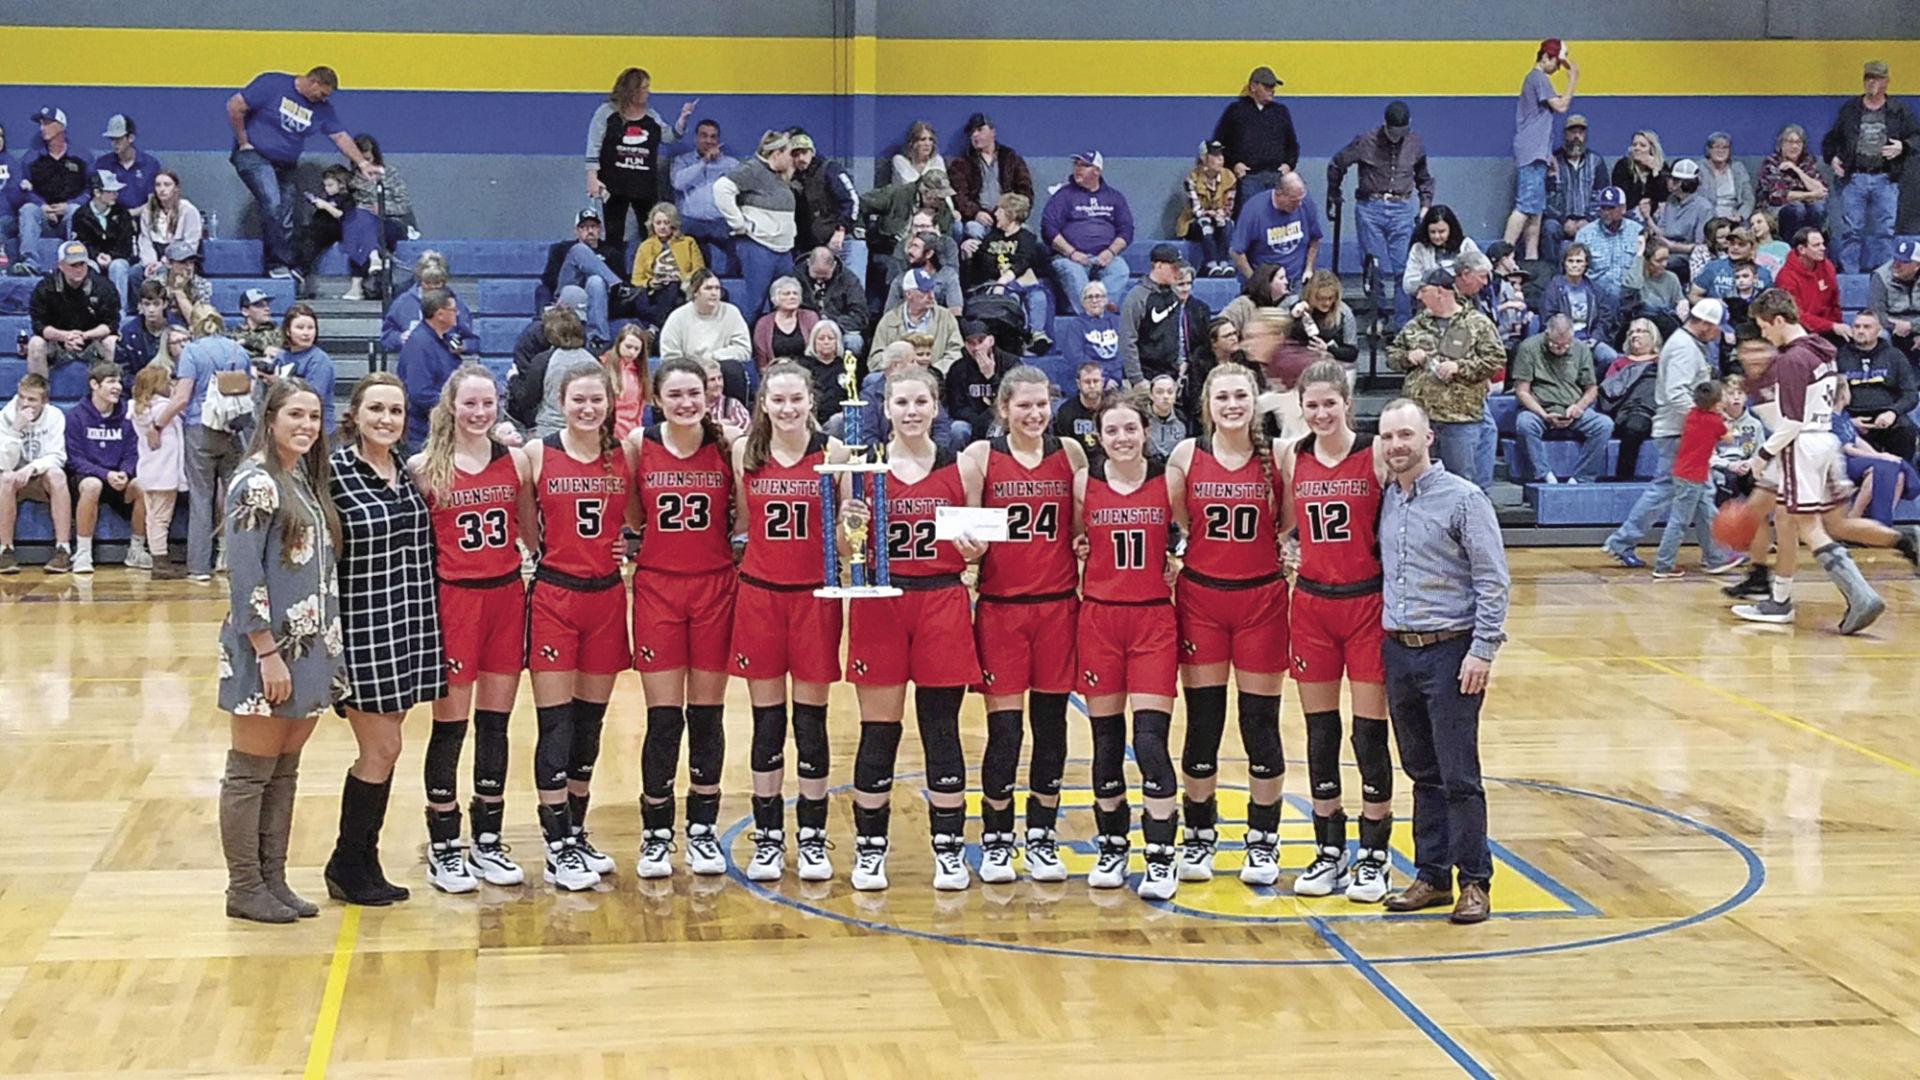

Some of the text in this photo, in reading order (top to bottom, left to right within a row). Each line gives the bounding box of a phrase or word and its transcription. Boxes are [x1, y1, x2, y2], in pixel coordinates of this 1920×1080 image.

[449, 485, 514, 507] UENSTE
[645, 471, 723, 488] MUENSTER
[993, 480, 1069, 498] MUENSTER
[1295, 478, 1369, 498] MUENSTER
[456, 508, 509, 552] 33
[576, 498, 603, 539] 5
[656, 492, 711, 532] 23
[764, 500, 809, 541] 21
[1007, 503, 1059, 542] 24
[1204, 503, 1259, 543] 20
[1305, 501, 1351, 543] 12
[888, 520, 938, 561] 22
[1111, 529, 1146, 570] 11
